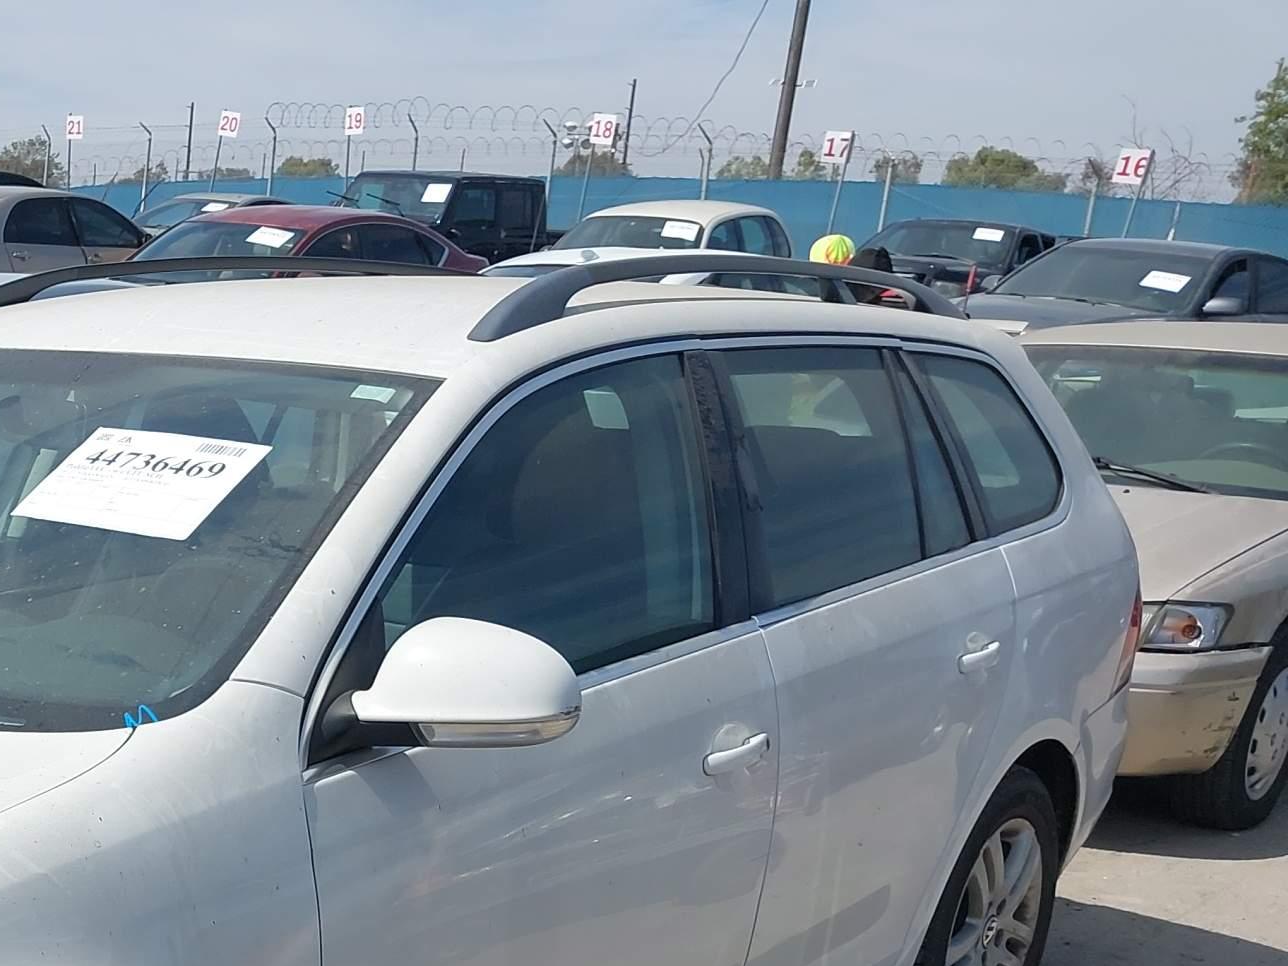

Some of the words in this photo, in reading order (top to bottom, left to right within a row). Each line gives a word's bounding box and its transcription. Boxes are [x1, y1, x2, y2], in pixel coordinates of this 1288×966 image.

[68, 120, 82, 135] 21
[220, 116, 238, 133] 20
[347, 112, 362, 129] 19
[592, 120, 613, 138] 18
[823, 137, 851, 158] 17
[1116, 155, 1149, 178] 16
[85, 449, 227, 479] 44736469
